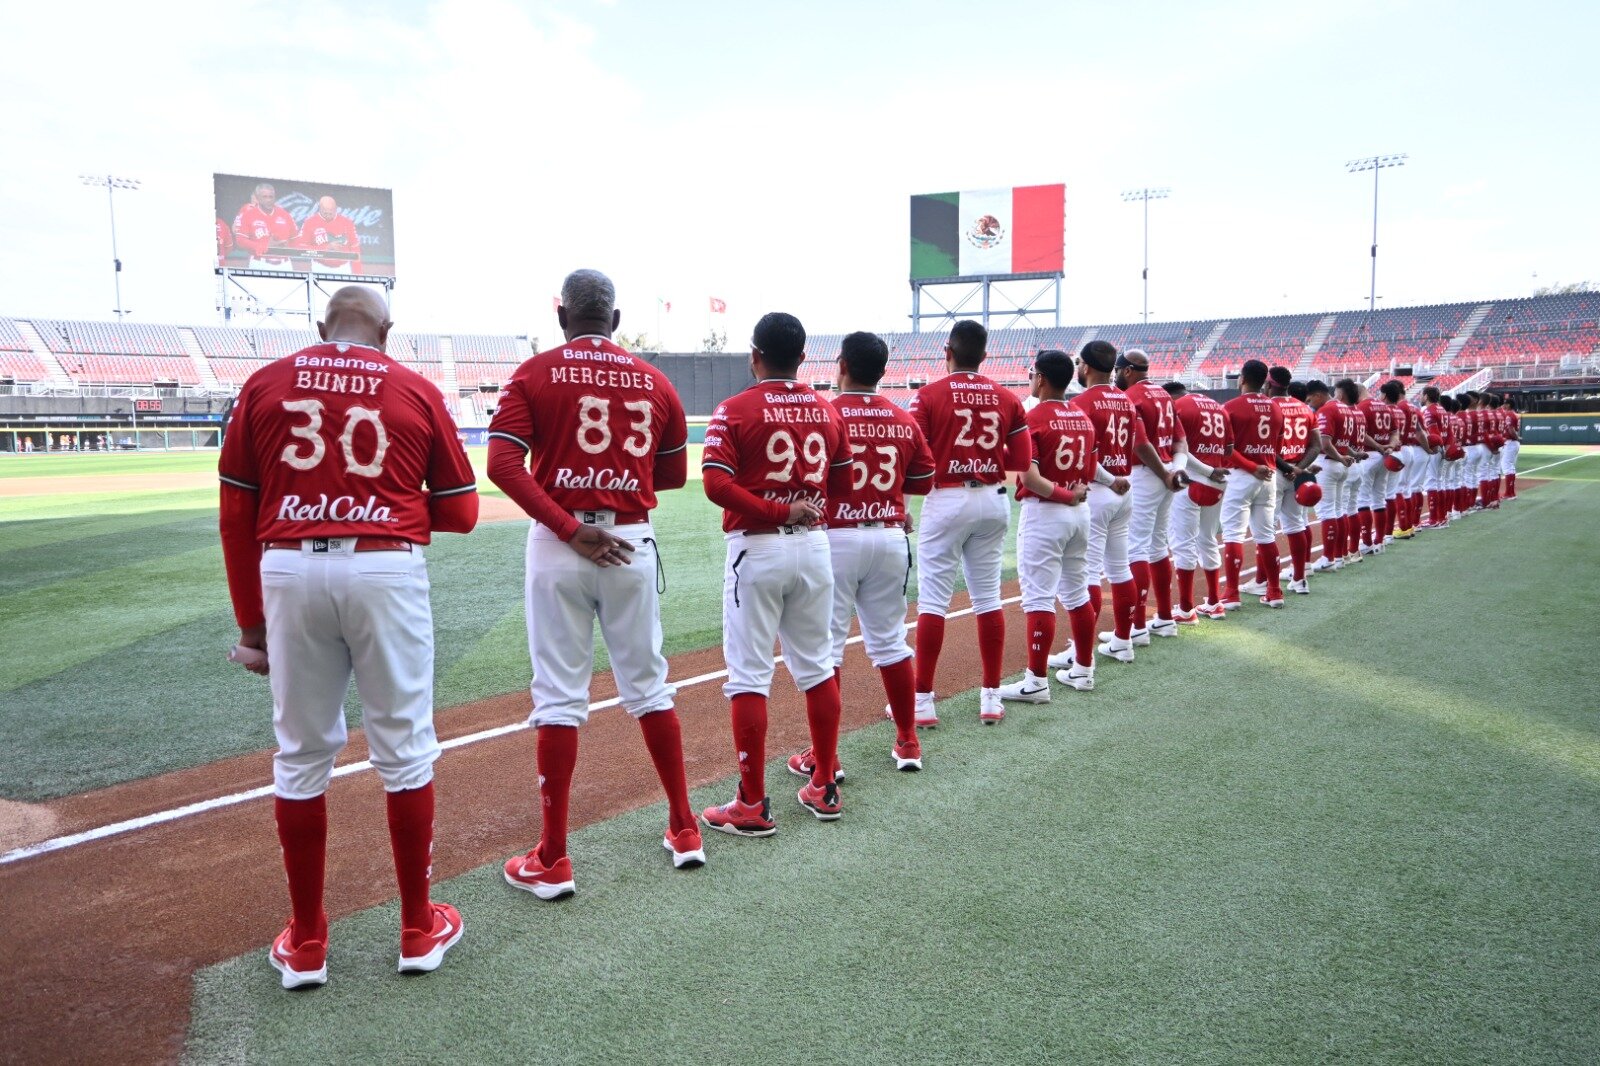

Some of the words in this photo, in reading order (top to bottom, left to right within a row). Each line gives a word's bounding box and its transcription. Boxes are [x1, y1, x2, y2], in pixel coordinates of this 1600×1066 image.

[294, 355, 389, 373] Banamex
[563, 349, 635, 366] Banamex
[295, 371, 383, 395] BUNDY
[551, 367, 654, 391] MERCEDES
[950, 381, 994, 391] Banamex
[764, 392, 817, 404] Banamex
[952, 392, 999, 405] FLORES
[1254, 404, 1271, 412] RUIZ
[763, 407, 830, 424] AMEZAGA
[841, 407, 894, 418] Banamex
[1376, 412, 1391, 430] 60
[577, 395, 653, 458] 83
[849, 424, 913, 440] REDONDO
[954, 408, 1000, 449] 23
[1105, 413, 1129, 447] 46
[1200, 411, 1225, 438] 38
[1258, 415, 1271, 439] 6
[1284, 418, 1307, 440] 56
[280, 399, 391, 478] 30
[765, 430, 828, 484] 99
[1055, 434, 1086, 471] 61
[851, 444, 898, 491] 53
